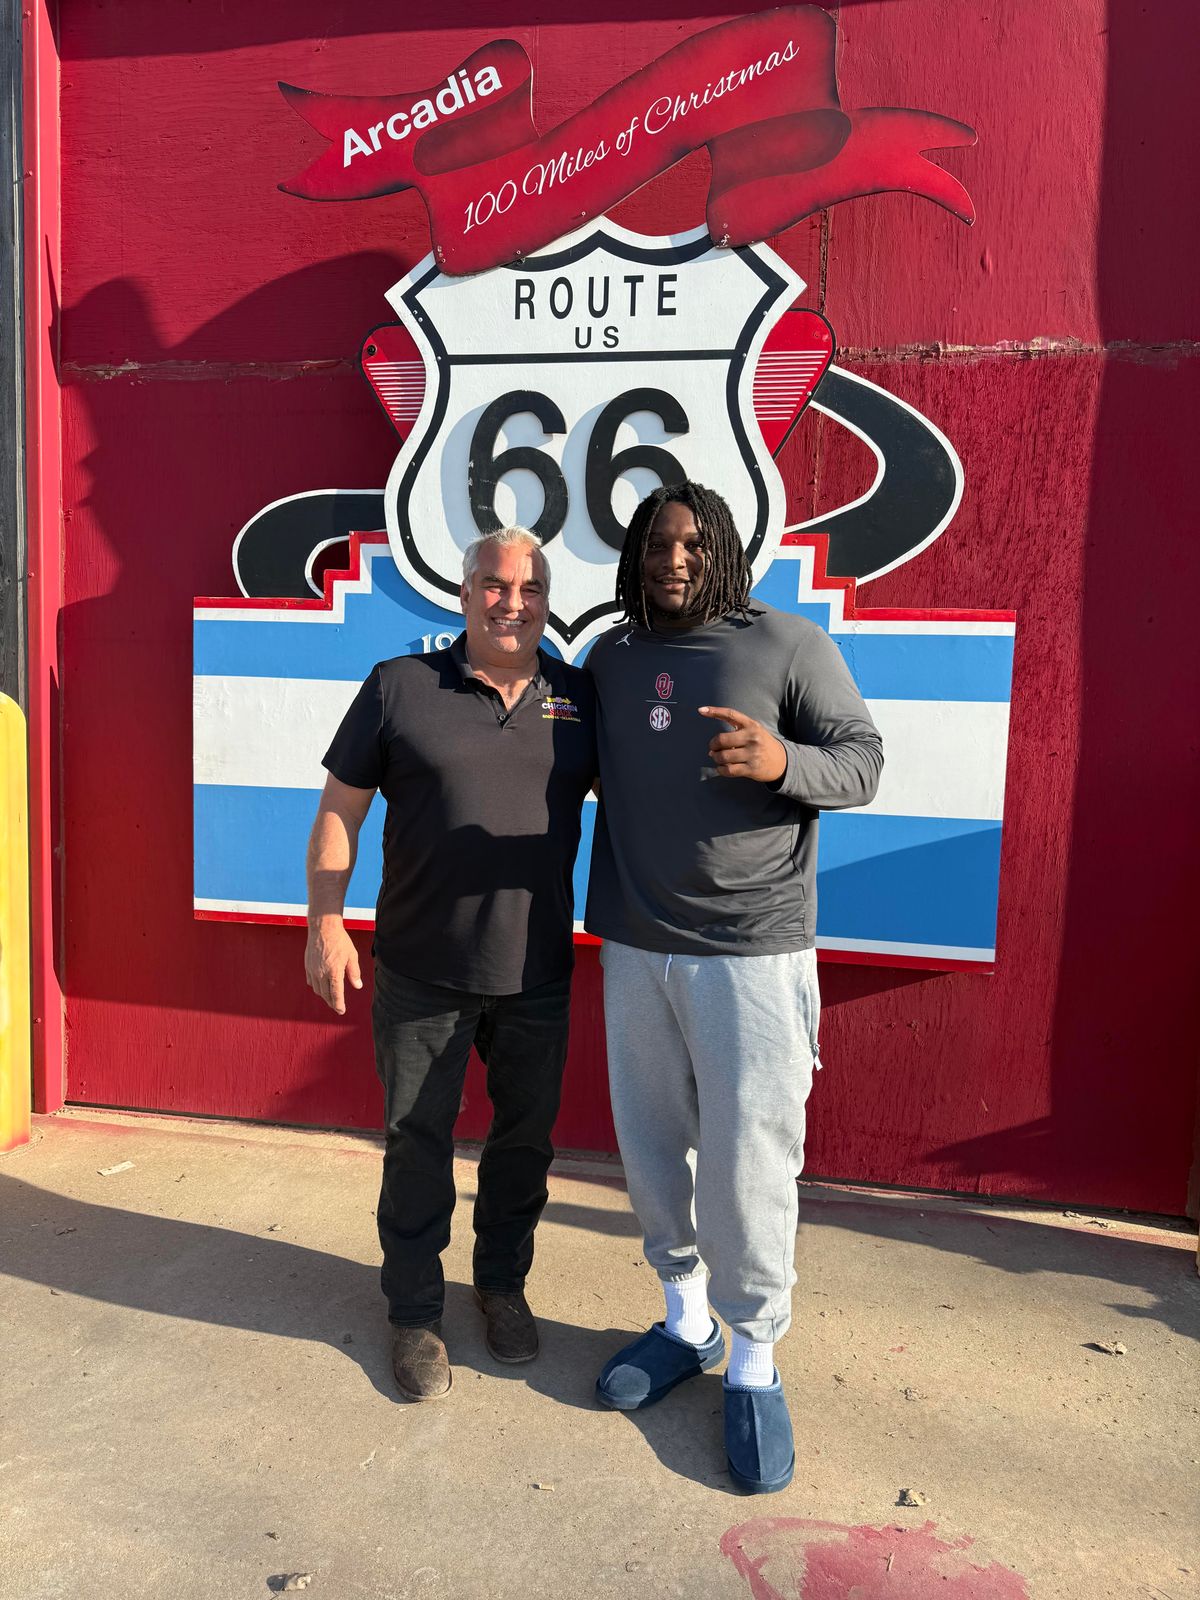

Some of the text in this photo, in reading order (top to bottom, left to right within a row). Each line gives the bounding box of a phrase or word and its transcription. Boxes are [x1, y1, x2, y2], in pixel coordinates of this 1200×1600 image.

[343, 65, 503, 168] Arcadia
[463, 40, 800, 234] 100 Miles of Christmas
[515, 274, 677, 320] ROUTE
[575, 326, 619, 349] US
[468, 387, 690, 552] 66
[655, 672, 674, 699] OU
[651, 706, 670, 729] SEC
